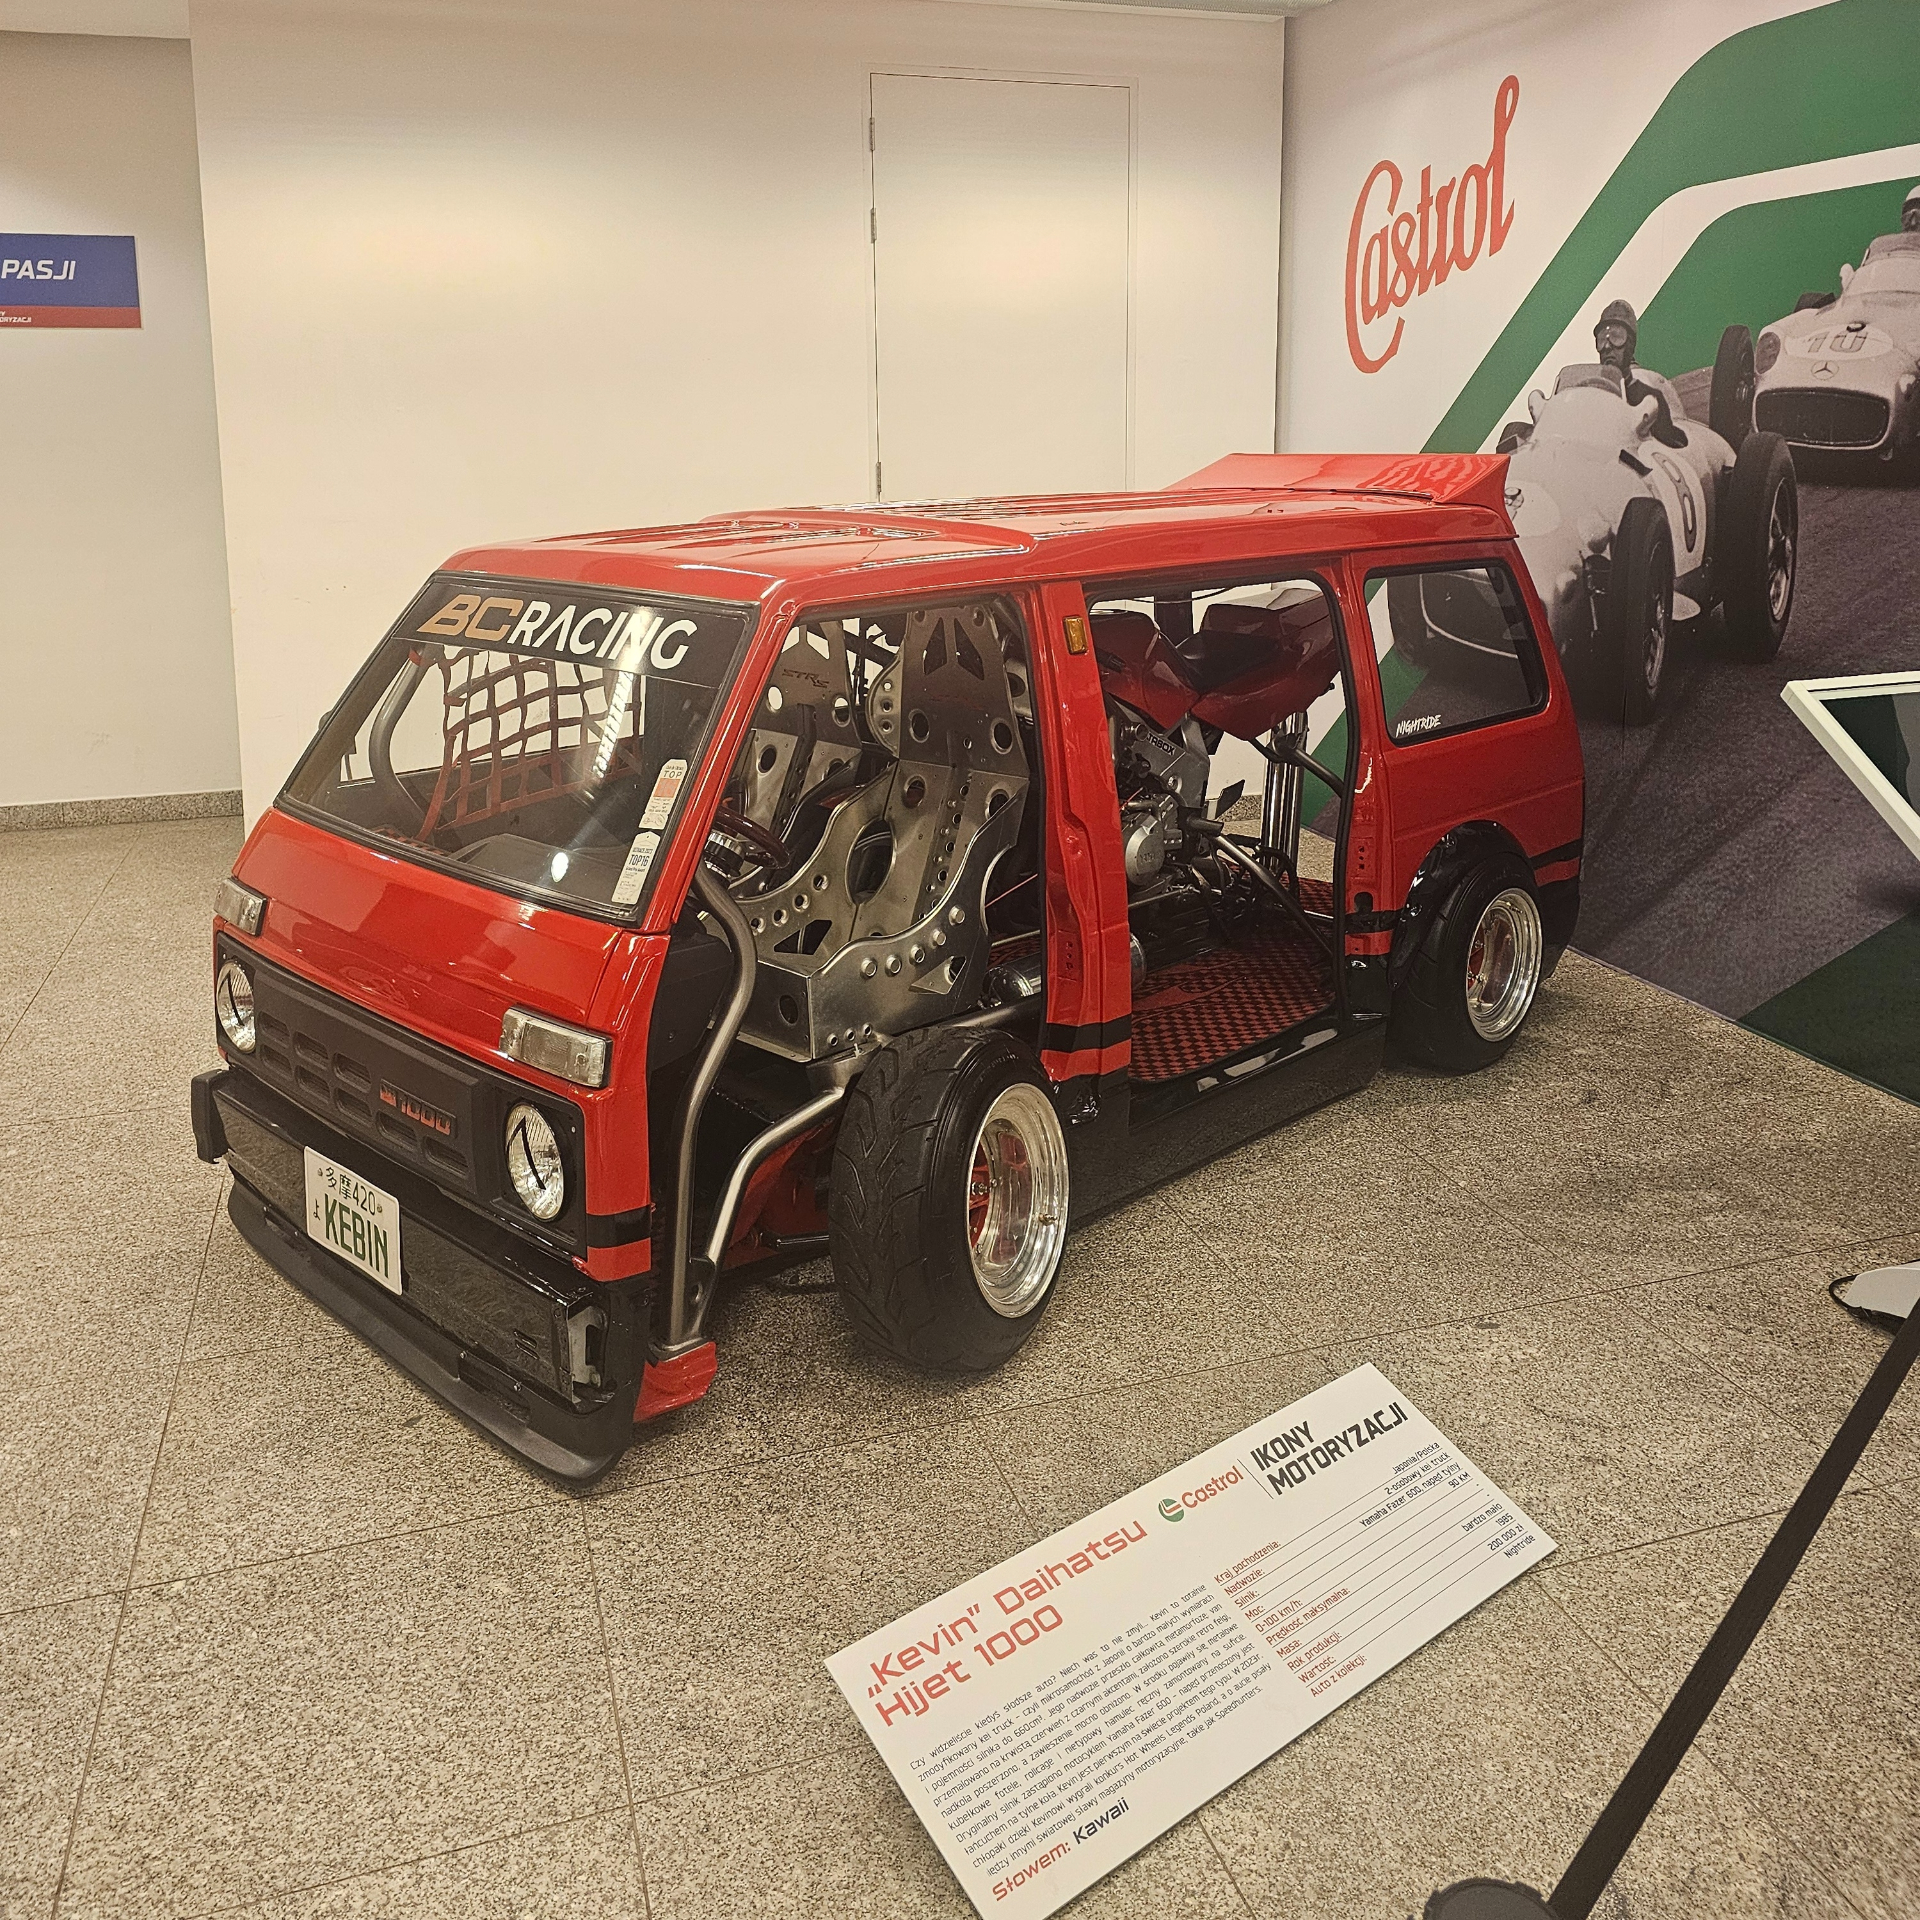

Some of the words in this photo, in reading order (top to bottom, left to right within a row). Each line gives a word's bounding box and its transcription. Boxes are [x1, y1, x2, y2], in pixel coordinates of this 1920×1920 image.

[1345, 74, 1520, 374] Castrol
[1, 258, 77, 282] PASJI
[1395, 714, 1442, 739] NIGHTRIDE
[663, 770, 683, 779] TOP
[324, 1193, 390, 1279] KEBIN
[1249, 1420, 1315, 1472] IKONY
[1266, 1401, 1409, 1496] MOTORYZACJI
[1391, 1442, 1440, 1475] Japonia/Polska
[1181, 1464, 1244, 1508] Castrol
[1358, 1507, 1389, 1527] Yamaha
[1385, 1494, 1407, 1511] Fazer
[1405, 1485, 1424, 1499] 600,
[1421, 1471, 1444, 1489] napęd
[1440, 1461, 1461, 1476] tylny
[1383, 1469, 1422, 1495] 2-osobowy
[1418, 1461, 1433, 1473] kei
[1427, 1451, 1451, 1467] truck
[1447, 1477, 1460, 1489] 90
[1456, 1470, 1471, 1483] KM
[1460, 1513, 1487, 1532] bardzo
[1484, 1502, 1503, 1518] mało
[1486, 1537, 1504, 1551] 200
[1500, 1527, 1517, 1542] 000
[1514, 1522, 1525, 1533] zł
[1494, 1512, 1514, 1527] 1985
[1213, 1568, 1234, 1584] Kraj
[1231, 1540, 1282, 1575] pochodzenia:
[1502, 1534, 1536, 1559] Nightride
[1223, 1568, 1266, 1596] Nadwozie:
[1233, 1590, 1260, 1609] Silnik:
[867, 1602, 980, 1699] „Kevin”
[992, 1520, 1148, 1616] Daihatsu
[1244, 1605, 1266, 1621] Moc:
[1254, 1613, 1280, 1633] 0-100
[1276, 1599, 1303, 1618] km/h:
[1265, 1616, 1304, 1646] Prędkość
[1301, 1587, 1353, 1622] maksymalna:
[874, 1659, 972, 1727] Hijet
[973, 1604, 1063, 1667] 1000
[1275, 1639, 1303, 1659] Masa:
[1286, 1655, 1306, 1671] Rok
[1303, 1630, 1343, 1661] produkcji:
[1297, 1654, 1337, 1683] Wartość:
[909, 1756, 926, 1770] Czy
[1034, 1674, 1057, 1693] auto?
[1058, 1661, 1081, 1678] Niech
[1081, 1650, 1099, 1663] was
[1149, 1607, 1170, 1622] Kevin
[1180, 1584, 1207, 1603] totalnie
[917, 1740, 978, 1782] zmodyfikowany
[991, 1718, 1015, 1735] truck
[1021, 1701, 1040, 1717] czyli
[1101, 1647, 1126, 1668] Japonii
[1130, 1630, 1157, 1648] bardzo
[1179, 1594, 1215, 1618] wymiarach
[975, 1743, 1001, 1763] silnika
[1047, 1702, 1066, 1718] Jego
[1065, 1680, 1100, 1705] nadwozie
[1208, 1603, 1223, 1614] van
[1310, 1679, 1332, 1698] Auto
[1329, 1674, 1338, 1684] z
[1334, 1653, 1368, 1679] kolekcji:
[932, 1766, 990, 1808] przemalowano
[1070, 1692, 1104, 1718] czarnymi
[1168, 1634, 1197, 1656] szerokie
[1195, 1623, 1215, 1638] retro
[940, 1794, 973, 1819] nadkola
[1028, 1729, 1074, 1762] zawieszenie
[1074, 1712, 1099, 1732] mocno
[1207, 1623, 1239, 1646] metalowe
[1023, 1758, 1055, 1781] rollcage
[1064, 1726, 1103, 1755] nietypowy
[1103, 1705, 1136, 1728] hamulec
[1162, 1656, 1209, 1690] zamontowany
[955, 1810, 999, 1843] Oryginalny
[999, 1796, 1021, 1815] silnik
[1063, 1740, 1108, 1773] motocyklem
[1105, 1721, 1136, 1742] Yamaha
[1134, 1707, 1155, 1725] Fazer
[1155, 1696, 1172, 1711] 600
[1199, 1651, 1241, 1683] przenoszony
[1239, 1642, 1255, 1657] jest
[1017, 1801, 1040, 1819] tylne
[1056, 1775, 1079, 1793] Kevin
[1076, 1765, 1095, 1782] jest
[1092, 1740, 1133, 1771] pierwszym
[1165, 1694, 1201, 1722] projektem
[1198, 1683, 1216, 1698] tego
[1030, 1799, 1066, 1828] Kevinowi
[1065, 1781, 1094, 1804] wygrali
[1092, 1761, 1125, 1786] konkurs
[1122, 1751, 1140, 1765] Hot
[1137, 1733, 1167, 1755] Wheels
[1164, 1713, 1196, 1737] Legends
[1232, 1676, 1252, 1692] aucie
[1008, 1837, 1037, 1861] innymi
[1097, 1771, 1135, 1801] magazyny
[1185, 1724, 1205, 1739] takie
[1203, 1716, 1217, 1730] jak
[992, 1841, 1071, 1902] Słowem:
[1072, 1796, 1129, 1845] Kawaii
